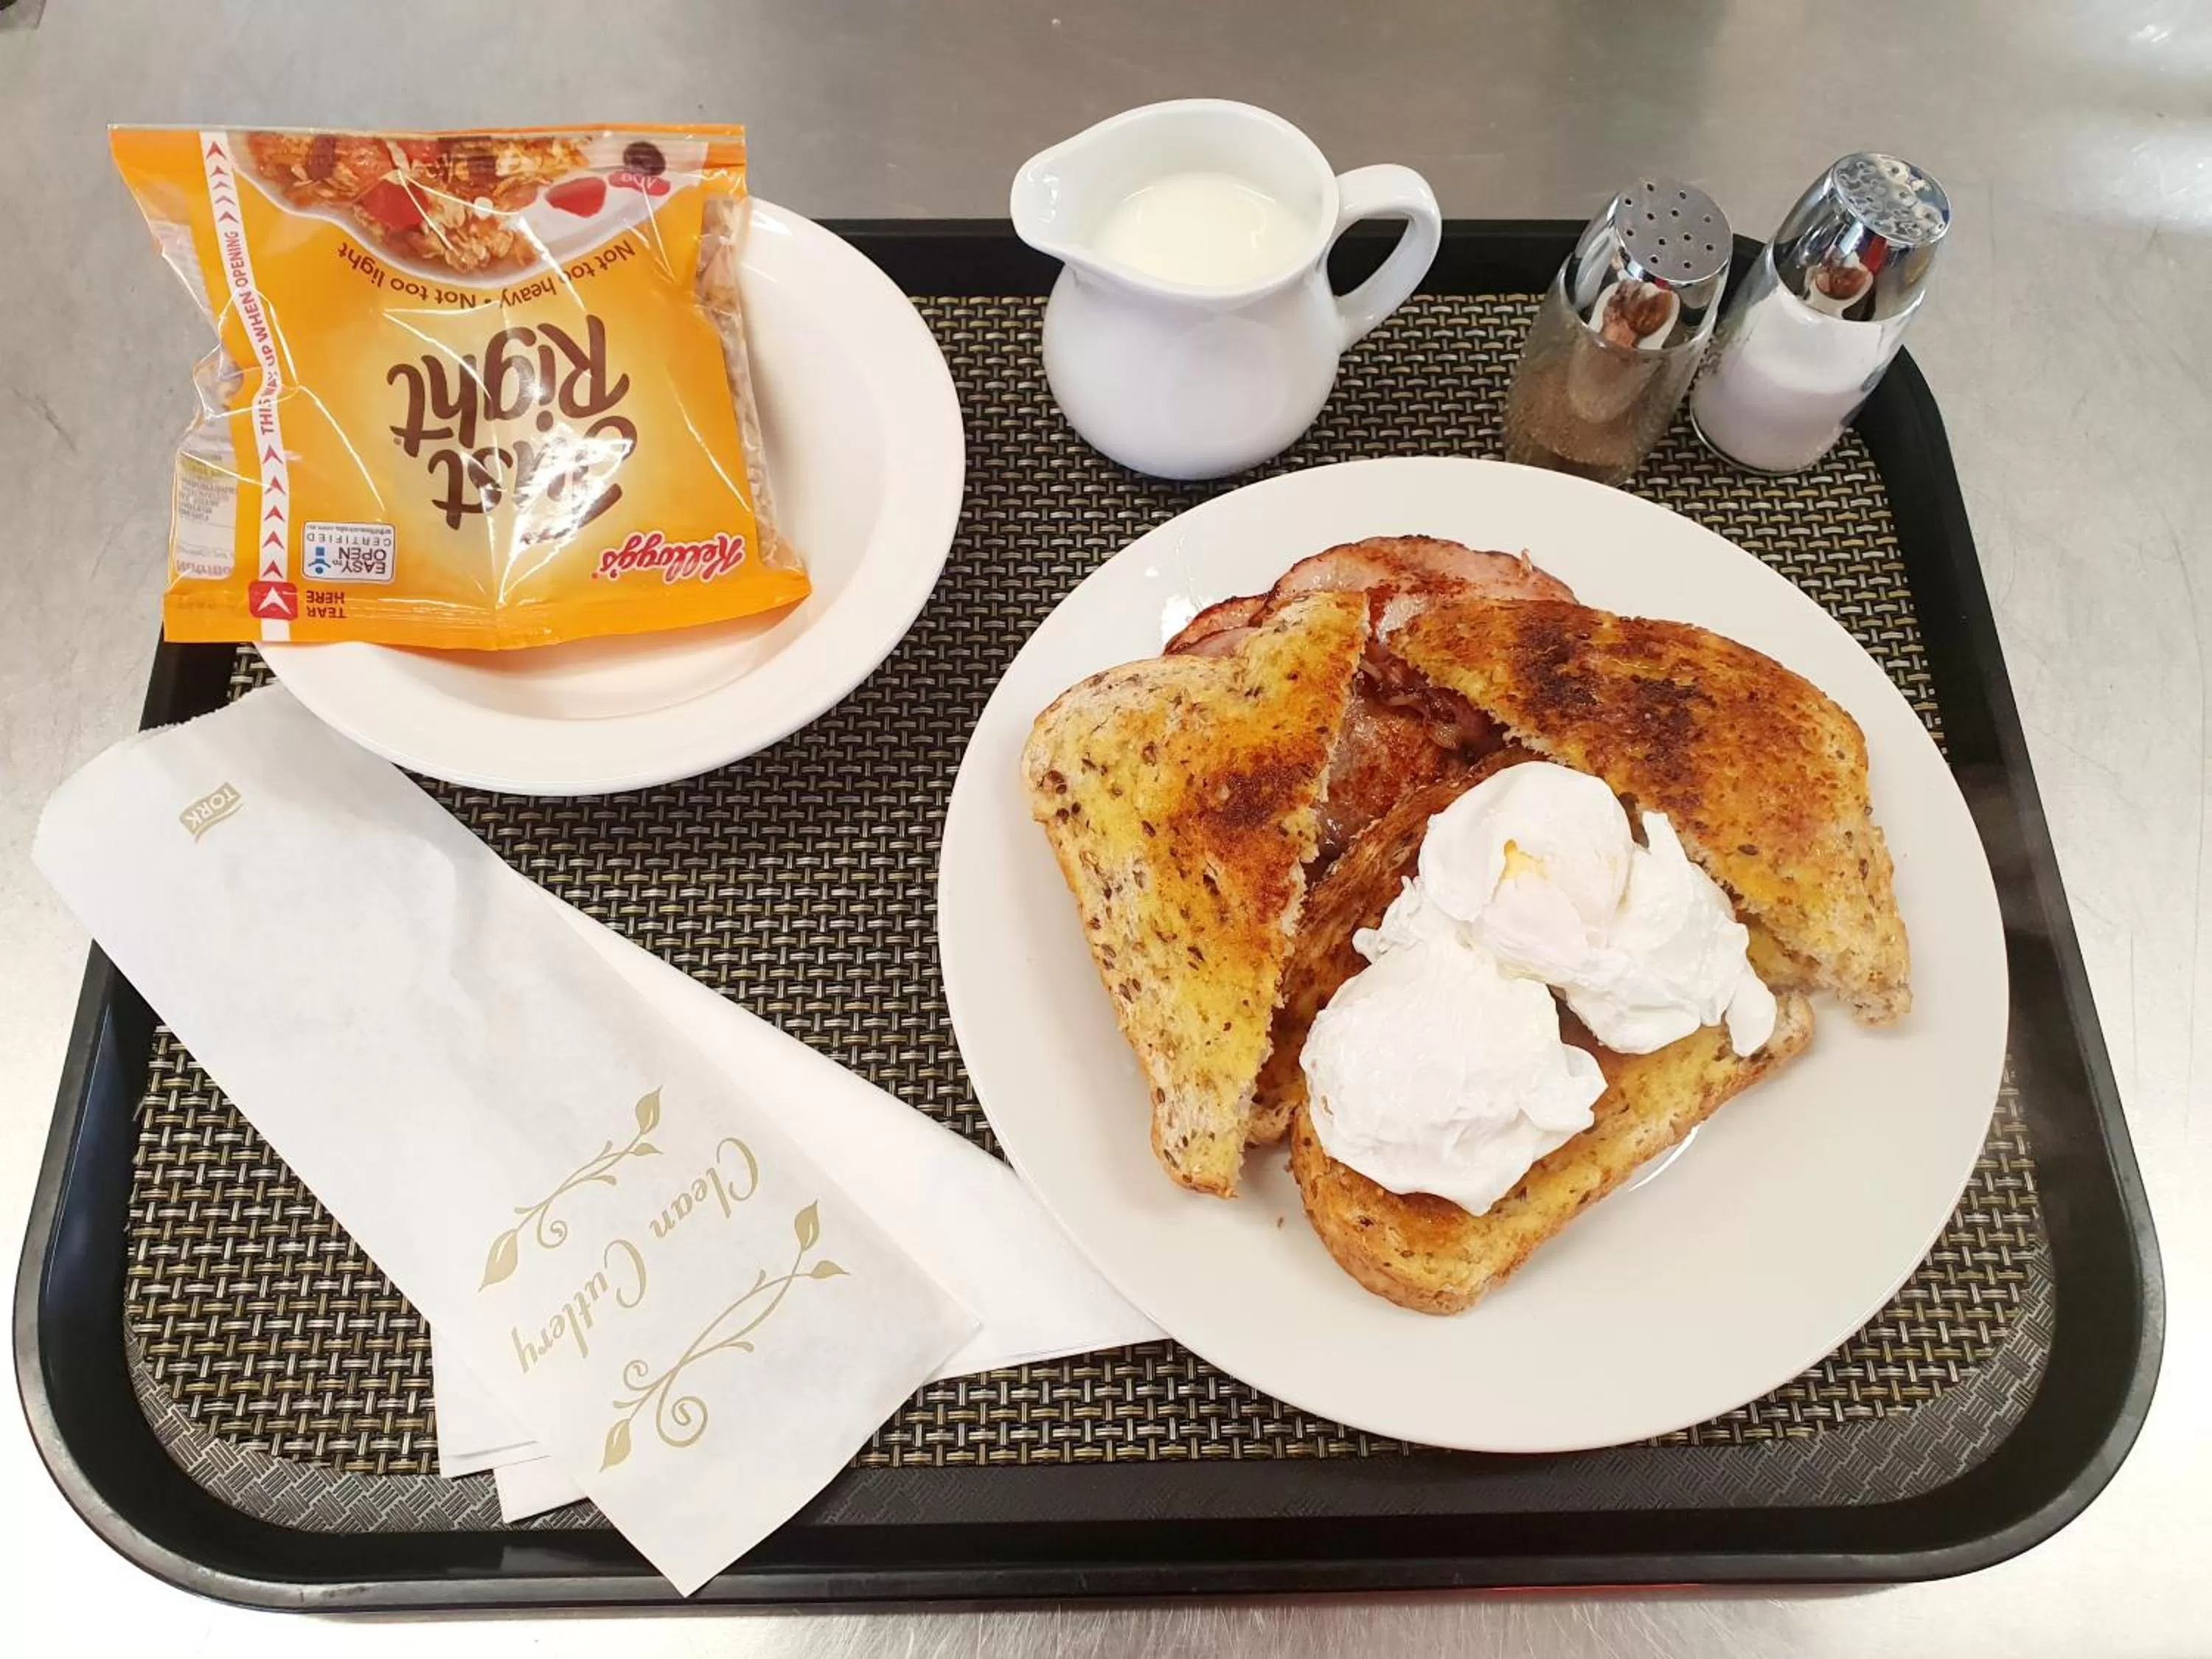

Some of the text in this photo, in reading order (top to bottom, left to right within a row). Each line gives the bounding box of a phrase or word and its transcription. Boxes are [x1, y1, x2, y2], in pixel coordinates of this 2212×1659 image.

[223, 230, 248, 288] OPENING
[336, 239, 636, 309] Not too heavy Not too light
[238, 290, 268, 343] WHEN
[261, 344, 276, 367] UP
[386, 314, 630, 458] Right
[258, 399, 275, 436] THIS
[306, 532, 392, 547] CERTIFIED
[338, 546, 387, 561] OPEN
[598, 532, 745, 583] Kellogg's
[341, 560, 386, 574] EASY
[306, 590, 346, 605] HERE
[306, 606, 347, 619] TEAR
[184, 785, 238, 832] TORK
[511, 1136, 759, 1374] Clean Cutlery
